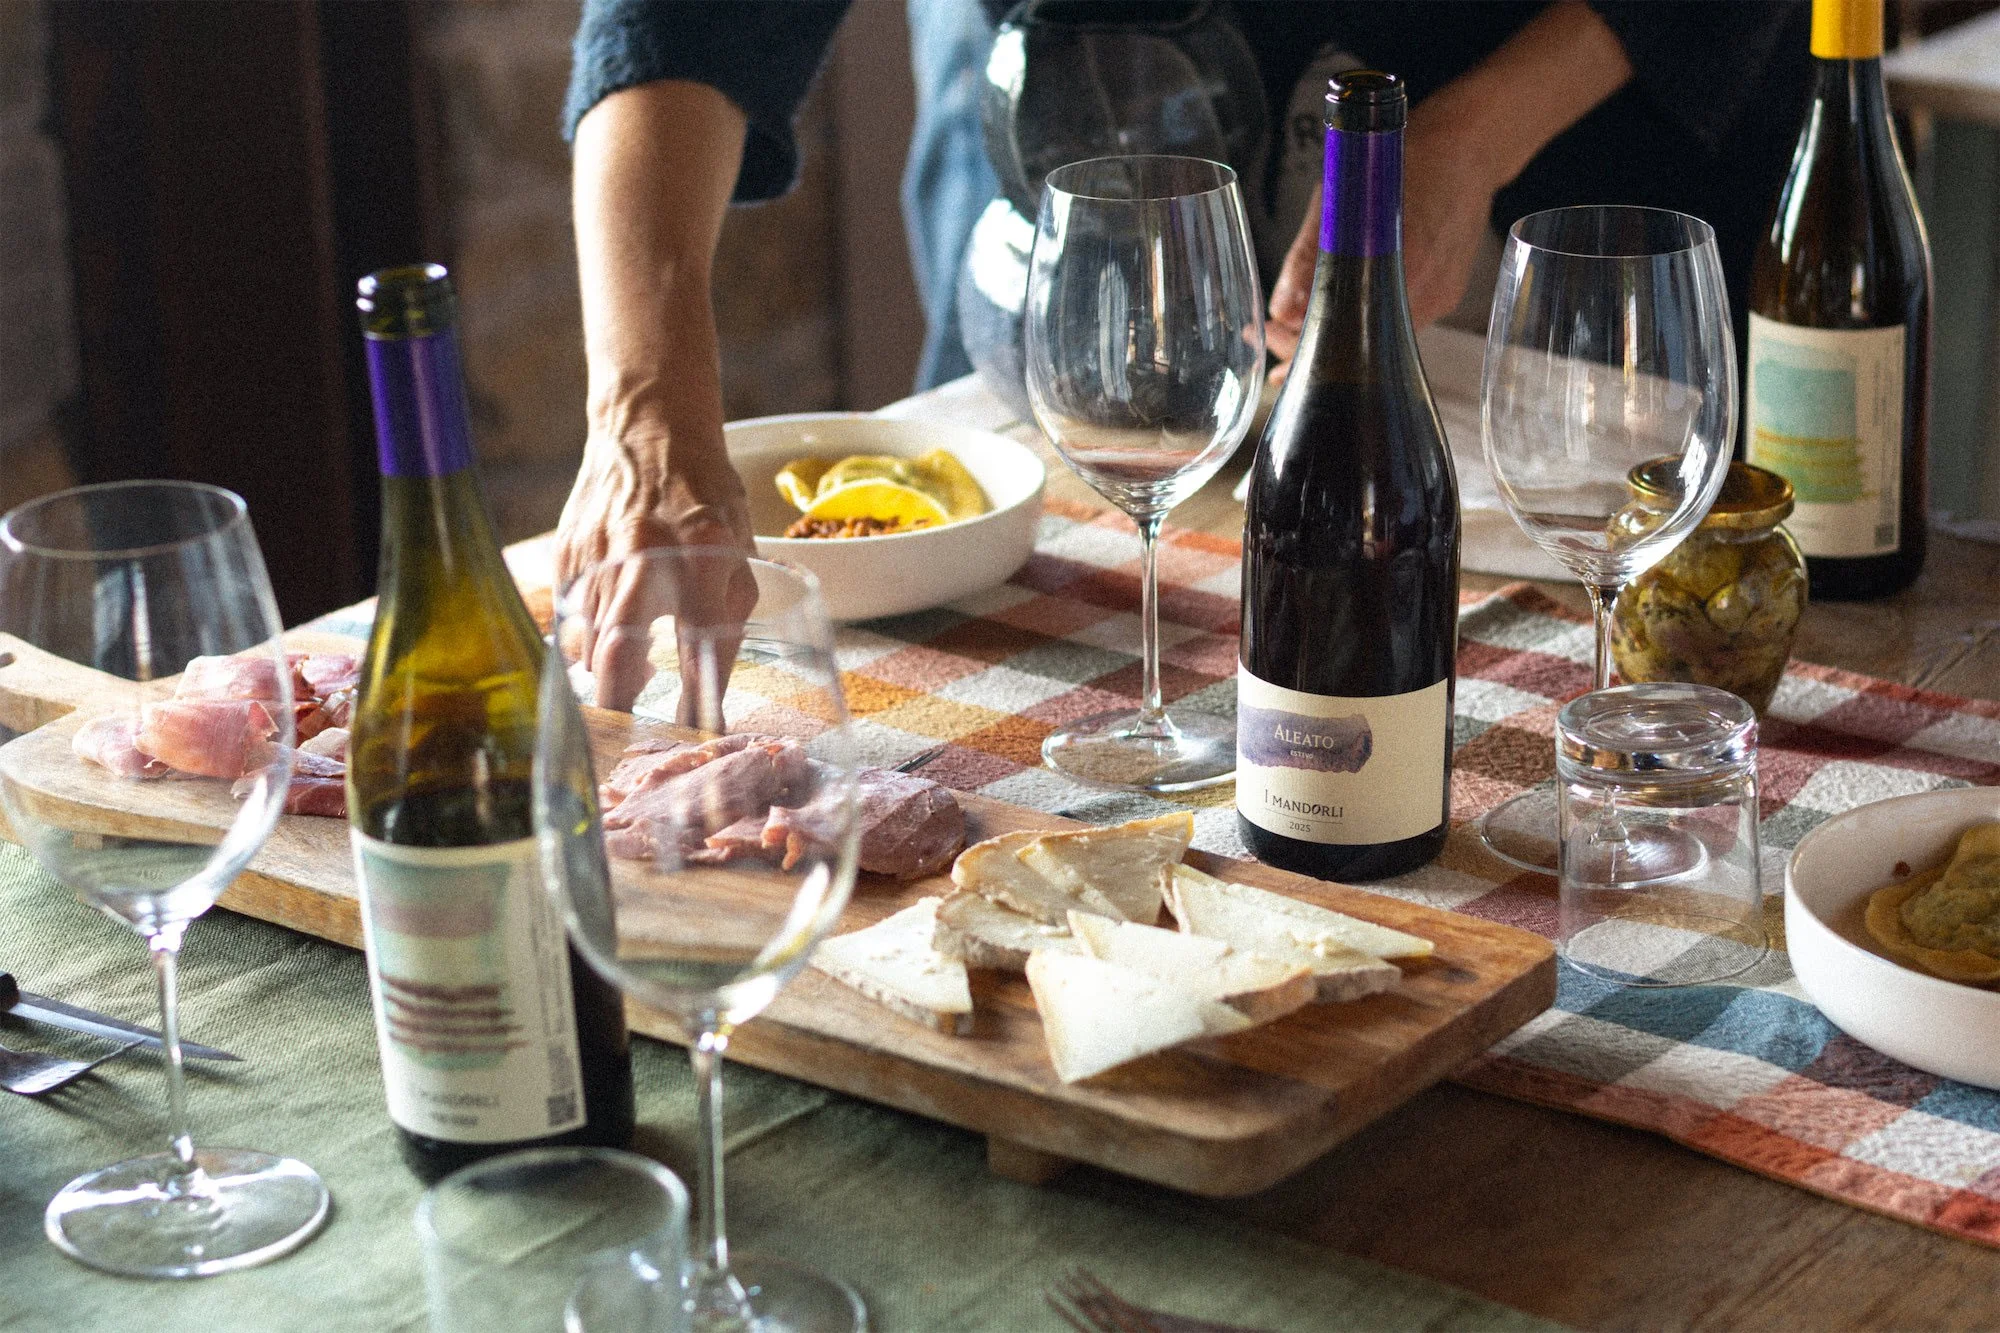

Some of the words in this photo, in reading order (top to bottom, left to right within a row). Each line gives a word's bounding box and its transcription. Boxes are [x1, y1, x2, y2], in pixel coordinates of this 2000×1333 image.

[1274, 723, 1334, 749] ALEATO
[1272, 795, 1343, 818] MANDORLI
[1289, 821, 1311, 832] 2025
